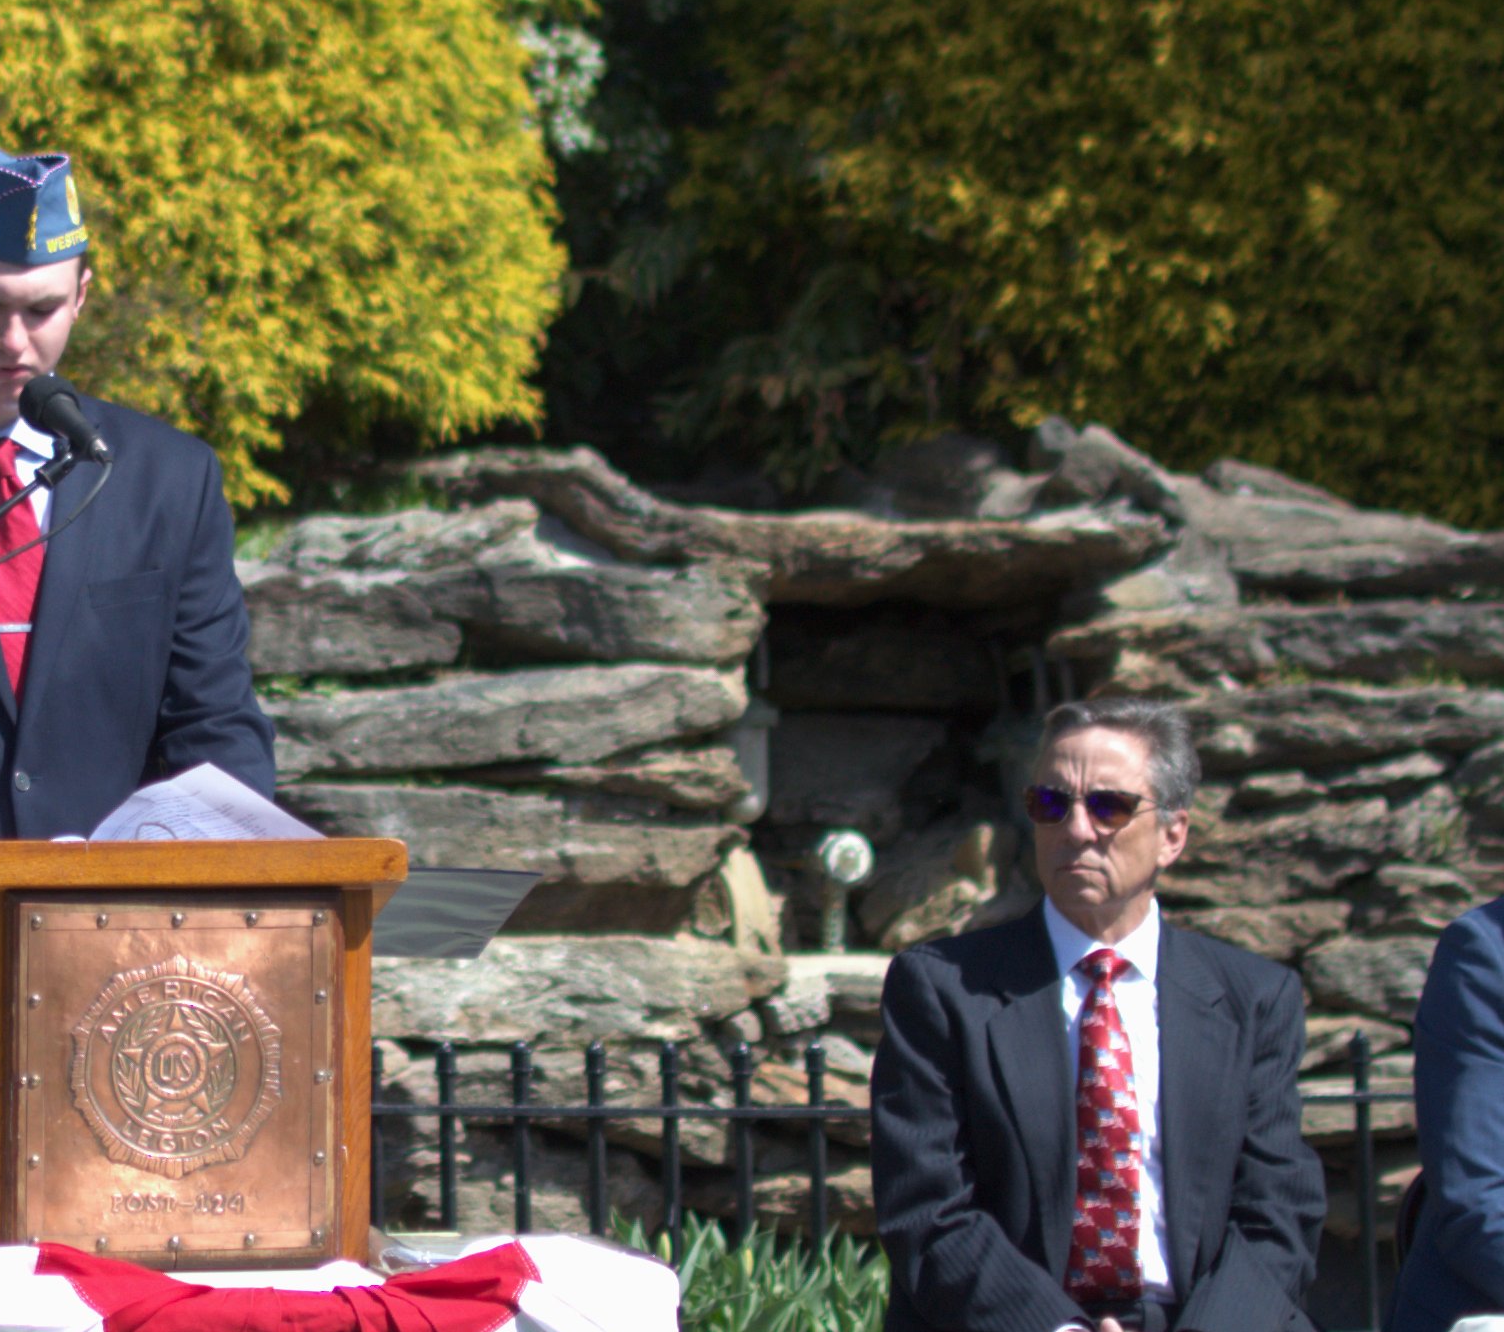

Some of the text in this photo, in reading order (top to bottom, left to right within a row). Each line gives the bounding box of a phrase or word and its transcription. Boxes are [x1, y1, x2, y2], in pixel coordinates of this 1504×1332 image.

[101, 981, 251, 1043] AMERICAN
[159, 1050, 193, 1082] US
[121, 1118, 231, 1152] LEGION
